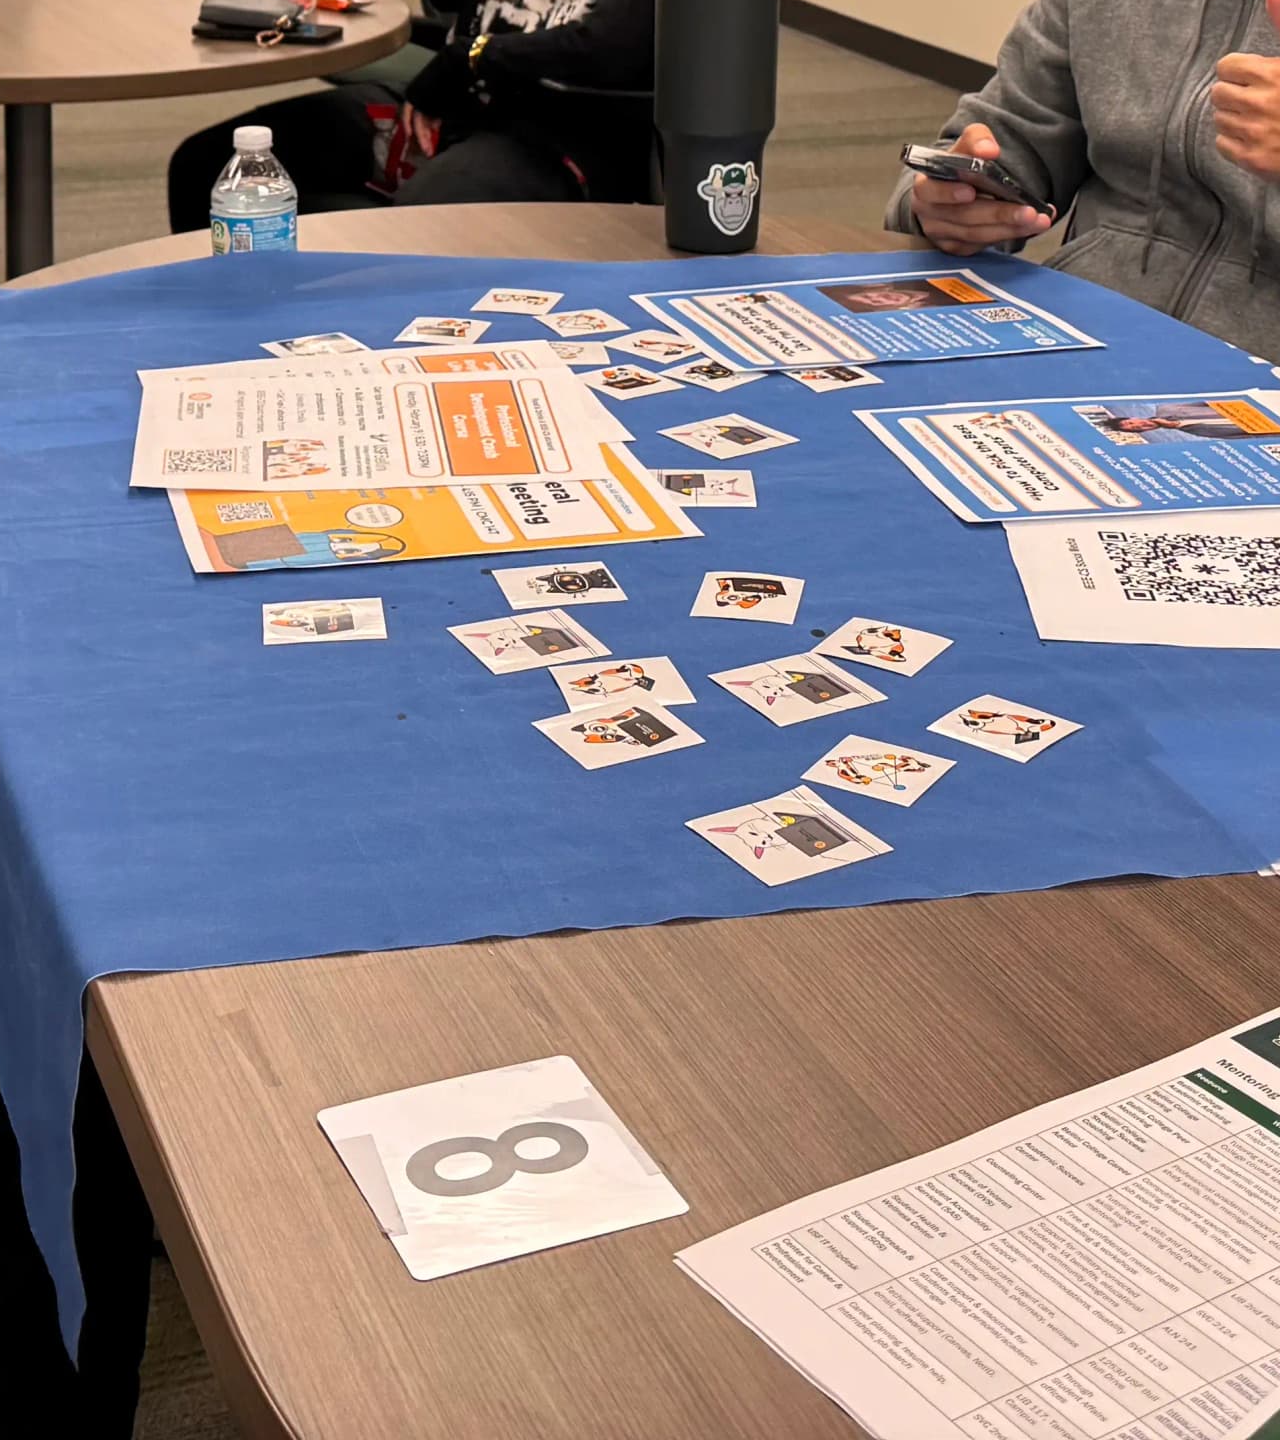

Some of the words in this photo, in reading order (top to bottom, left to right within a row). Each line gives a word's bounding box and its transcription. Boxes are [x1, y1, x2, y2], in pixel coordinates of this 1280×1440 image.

[791, 339, 812, 351] Like
[409, 409, 420, 428] February
[452, 414, 468, 438] Course
[470, 392, 492, 436] Development
[481, 437, 499, 458] Crash
[496, 404, 519, 447] Professional
[952, 424, 977, 439] Best
[972, 440, 992, 452] the
[986, 454, 1011, 469] Pick
[1005, 470, 1021, 479] To
[1013, 456, 1059, 490] Computer
[1068, 458, 1095, 479] February
[544, 481, 579, 503] eral
[467, 498, 482, 507] PM
[475, 511, 493, 524] CMC
[1195, 1072, 1227, 1093] Resource
[1216, 1058, 1280, 1099] Mentoring
[1143, 1094, 1172, 1112] Tutoring
[1167, 1084, 1201, 1105] Academic
[1200, 1104, 1231, 1125] Advising
[1172, 1103, 1199, 1121] College
[1197, 1093, 1223, 1110] College
[1081, 1118, 1114, 1140] Coaching
[1117, 1104, 1152, 1128] Mentoring
[1146, 1114, 1173, 1133] College
[1171, 1131, 1190, 1144] Peer
[1051, 1130, 1077, 1148] Advisor
[1091, 1114, 1118, 1133] Student
[1116, 1132, 1144, 1152] Success
[1120, 1125, 1147, 1144] College
[405, 1121, 589, 1197] 8
[1014, 1145, 1038, 1162] Center
[1024, 1141, 1057, 1166] Academic
[1056, 1164, 1084, 1186] Success
[1081, 1140, 1107, 1160] College
[1106, 1159, 1131, 1176] Career
[947, 1172, 975, 1192] Success
[957, 1168, 978, 1183] Office
[985, 1188, 1012, 1209] Veteran
[985, 1157, 1023, 1185] Counseling
[1020, 1183, 1045, 1200] Center
[890, 1194, 918, 1215] Student
[916, 1214, 939, 1232] Health
[914, 1185, 942, 1206] Services
[940, 1205, 962, 1221] (SAS)
[924, 1181, 952, 1201] Student
[949, 1200, 991, 1231] Accessibility
[840, 1214, 868, 1235] Support
[864, 1234, 887, 1251] (SOS)
[850, 1210, 878, 1231] Student
[876, 1230, 907, 1255] Outreach
[881, 1198, 911, 1222] Wellness
[909, 1221, 934, 1239] Center
[1037, 1222, 1066, 1243] Support
[772, 1242, 812, 1276] Professional
[781, 1237, 804, 1256] Center
[802, 1255, 815, 1265] for
[812, 1264, 836, 1283] Career
[806, 1227, 822, 1238] USF
[827, 1244, 858, 1270] Helpdesk
[988, 1241, 1017, 1263] support
[1088, 1227, 1130, 1257] confidential
[1128, 1256, 1157, 1275] mental
[1154, 1274, 1179, 1292] health
[1099, 1246, 1138, 1274] workshops
[760, 1247, 804, 1283] Development
[949, 1258, 978, 1281] services
[908, 1276, 946, 1305] challenges
[918, 1271, 949, 1296] students
[947, 1294, 971, 1314] facing
[1047, 1252, 1085, 1282] community
[1083, 1281, 1119, 1307] programs
[1059, 1249, 1071, 1258] VA
[1099, 1280, 1144, 1312] educational
[929, 1267, 948, 1282] Case
[946, 1280, 975, 1303] support
[979, 1307, 1015, 1335] resources
[1013, 1334, 1027, 1344] for
[1013, 1285, 1039, 1304] urgent
[885, 1286, 919, 1312] Technical
[915, 1311, 944, 1334] support
[848, 1301, 872, 1320] Career
[901, 1346, 929, 1369] resume
[1046, 1322, 1079, 1348] wellness
[873, 1337, 889, 1349] job
[886, 1347, 912, 1369] search
[1098, 1356, 1127, 1377] 12530
[1144, 1354, 1168, 1371] 1133
[1062, 1372, 1094, 1398] Through
[1087, 1360, 1104, 1373] Run
[1103, 1372, 1125, 1390] Drive
[1015, 1393, 1032, 1406] LIB
[1039, 1382, 1067, 1403] offices
[1051, 1377, 1083, 1402] Student
[1081, 1401, 1107, 1422] Affairs
[972, 1413, 992, 1428] SVC
[1004, 1398, 1036, 1425] Campus
